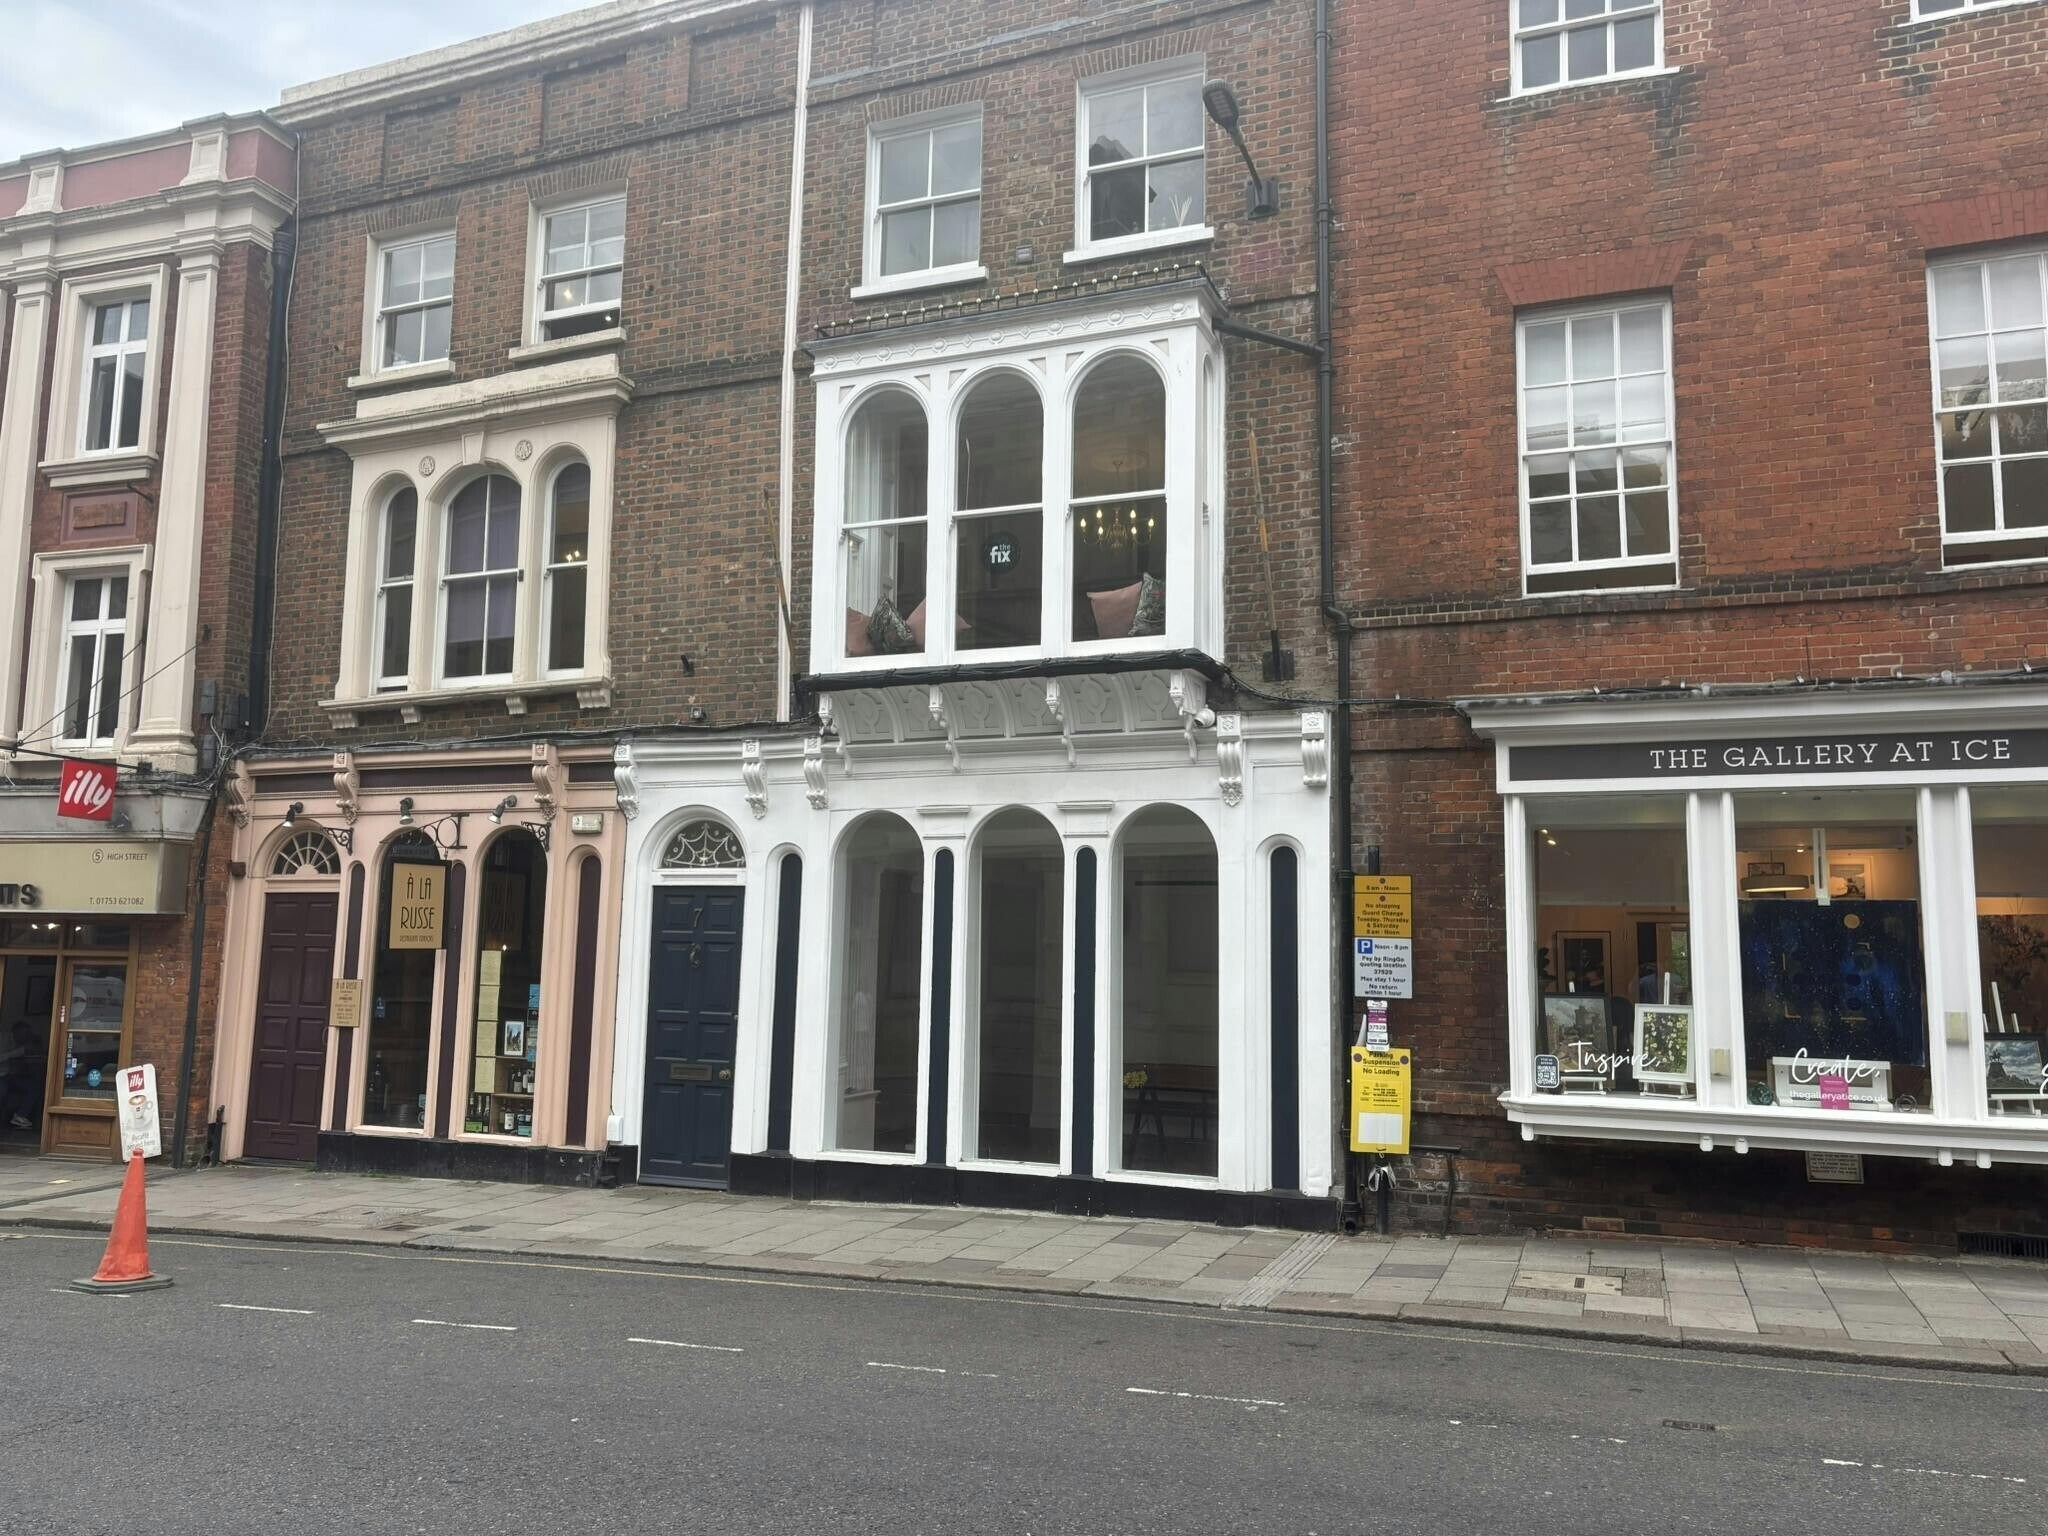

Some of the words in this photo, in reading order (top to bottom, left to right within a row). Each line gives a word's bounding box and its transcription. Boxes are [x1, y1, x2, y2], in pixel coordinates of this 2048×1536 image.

[990, 545, 1011, 563] fix
[1650, 749, 1707, 769] THE
[1723, 743, 1879, 768] GALLERY
[1889, 741, 1933, 764] AT
[1951, 739, 2011, 761] ICE
[64, 769, 112, 815] illy
[107, 852, 123, 861] HIGH
[125, 852, 148, 861] STREET
[420, 876, 432, 900] LA
[96, 896, 116, 905] 01753
[400, 906, 435, 930] RUSSE
[694, 907, 703, 928] 7
[1381, 910, 1404, 918] Change
[1363, 1058, 1400, 1066] Suspension
[1374, 1068, 1400, 1076] Loading
[129, 1073, 144, 1088] illy
